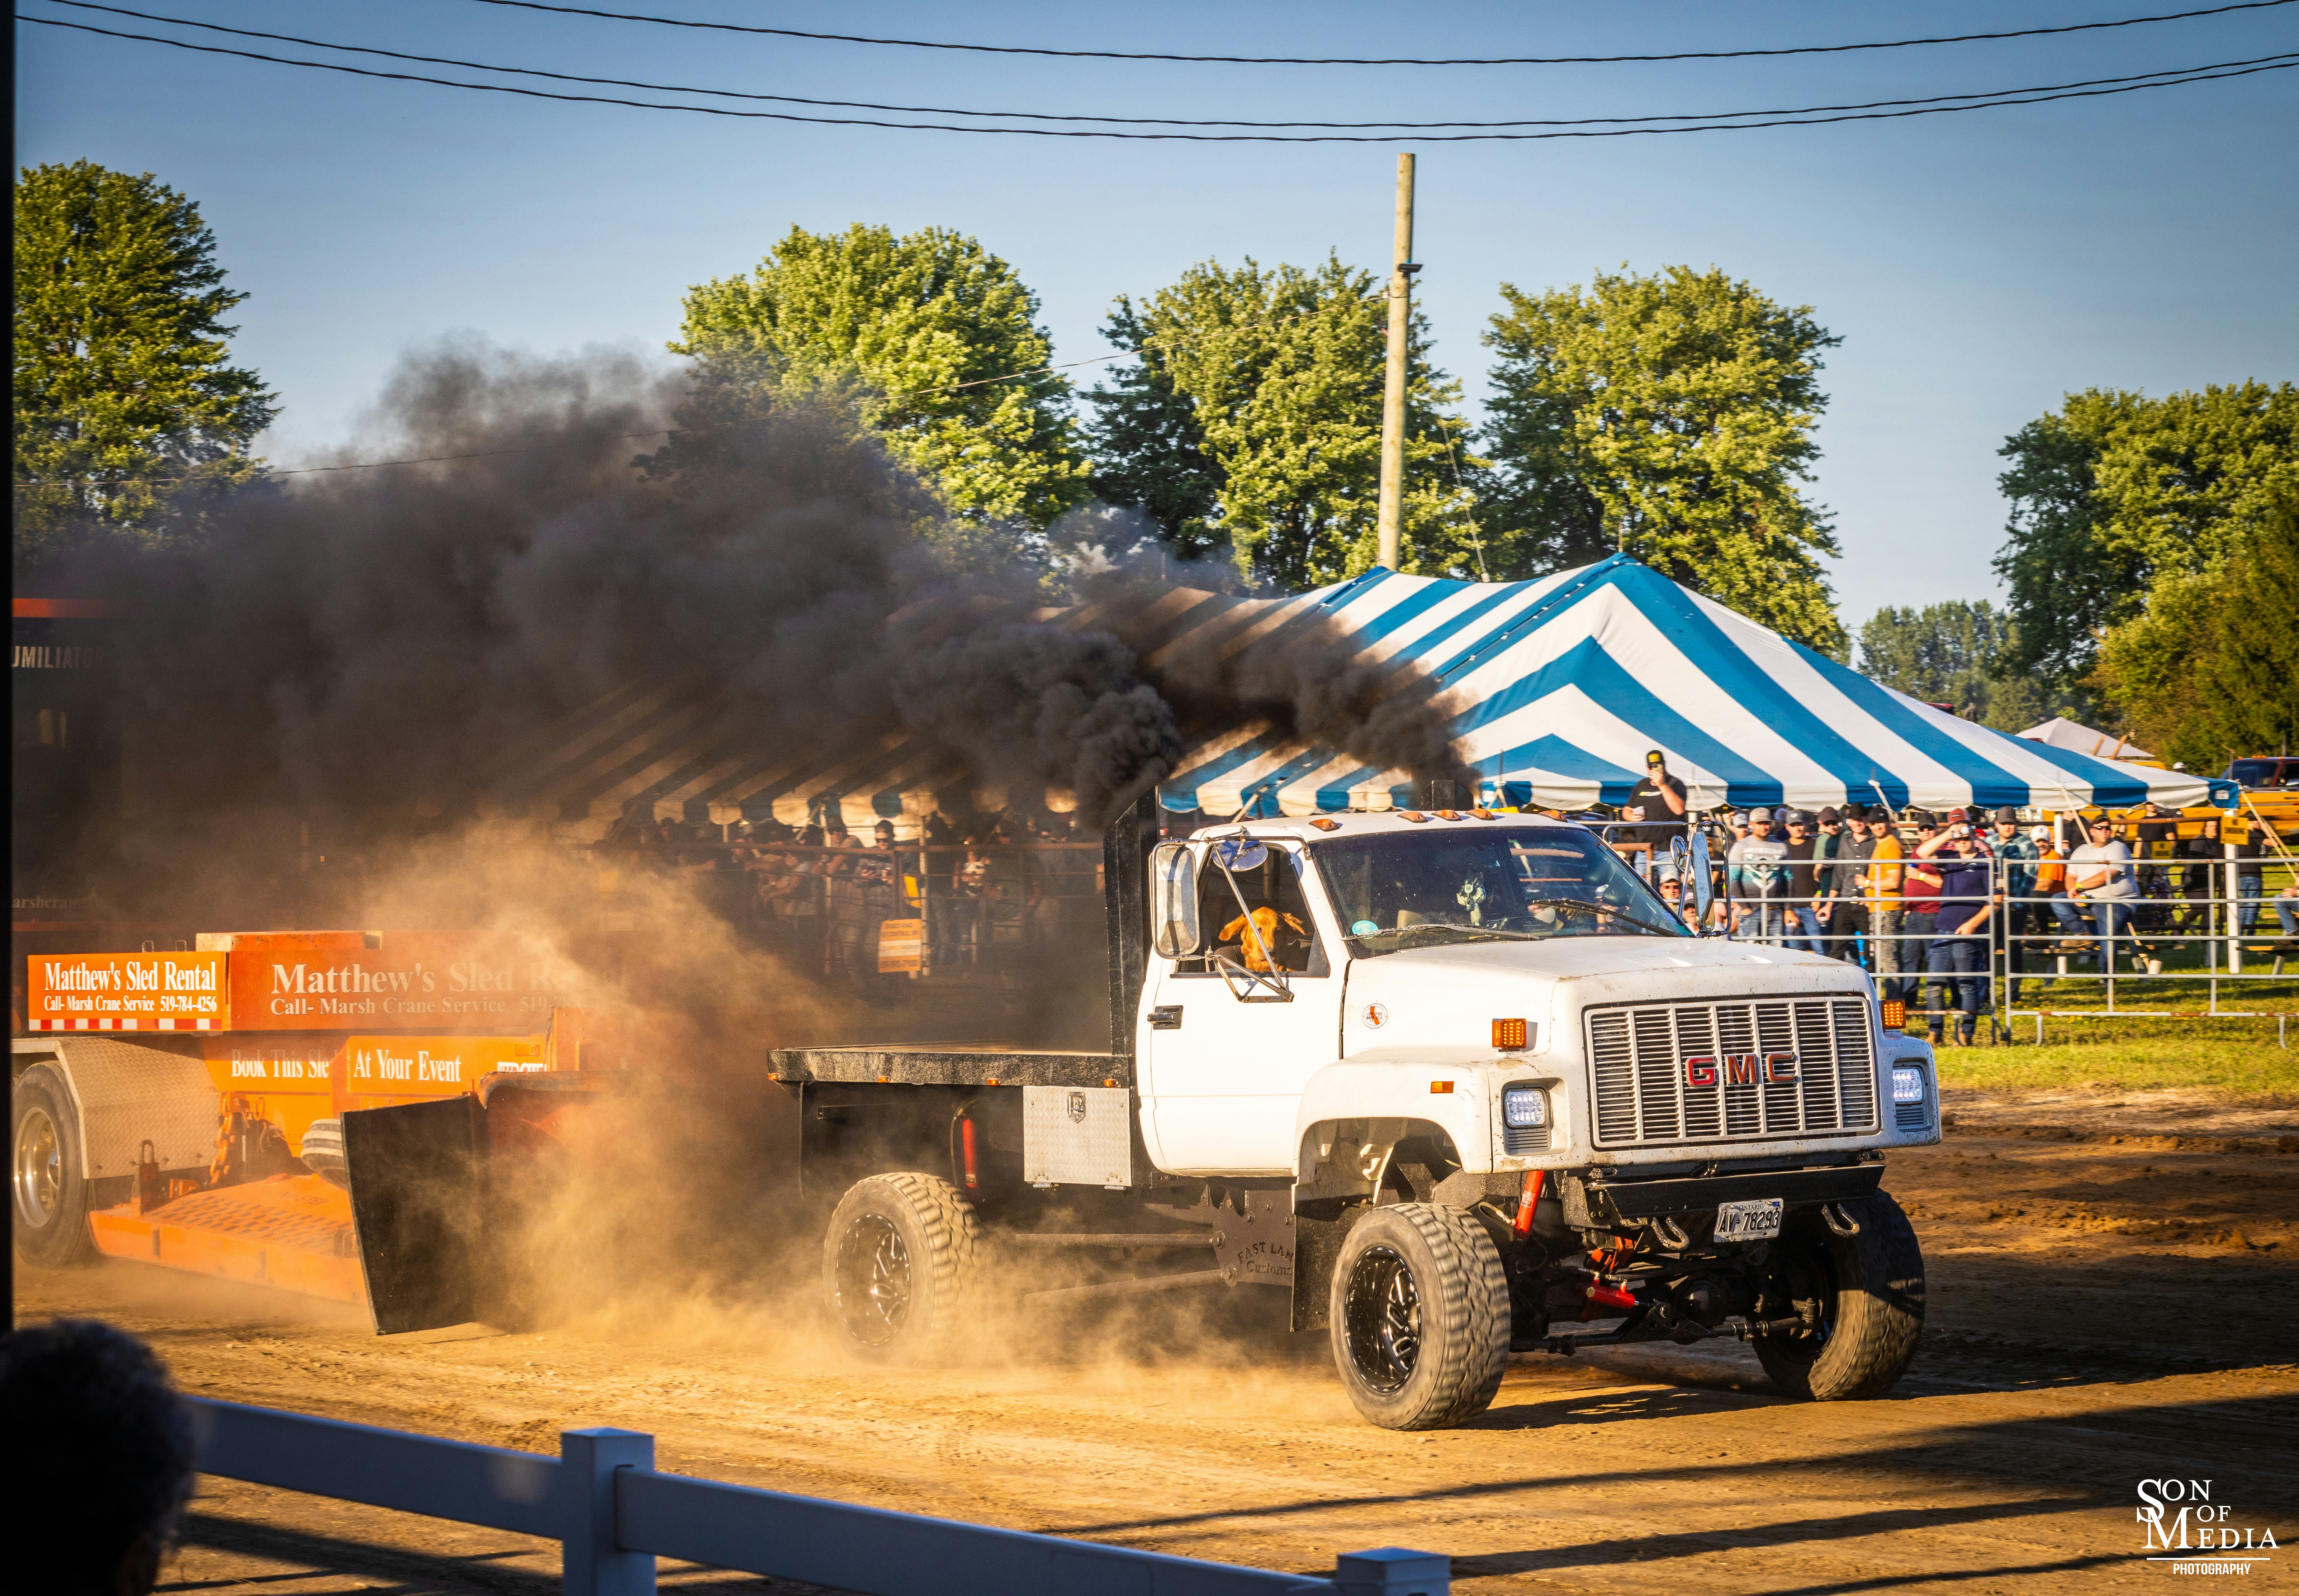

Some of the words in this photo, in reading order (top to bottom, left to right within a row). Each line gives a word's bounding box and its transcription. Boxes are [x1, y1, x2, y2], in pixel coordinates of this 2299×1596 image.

[44, 961, 120, 991] Matthew's
[127, 961, 159, 991] Sled
[164, 961, 217, 991] Rental
[271, 963, 435, 994] Matthew's
[448, 962, 513, 992] Sled
[44, 995, 65, 1011] Call-
[66, 995, 93, 1011] Marsh
[95, 995, 121, 1011] Crane
[123, 995, 155, 1012] Service
[160, 996, 217, 1012] 519-784-4256
[270, 998, 314, 1015] Call-
[319, 998, 375, 1014] Marsh
[383, 997, 435, 1013] Crane
[442, 996, 506, 1013] Service
[231, 1049, 267, 1077] Book
[271, 1049, 303, 1077] This
[308, 1049, 336, 1078] Sle
[353, 1049, 371, 1078] At
[376, 1049, 413, 1079] Your
[417, 1051, 461, 1082] Event
[1686, 1052, 1796, 1088] GMC
[1717, 1212, 1736, 1232] AV
[1742, 1210, 1779, 1231] 78293
[1237, 1242, 1265, 1264] FAST
[1247, 1260, 1292, 1276] Customs
